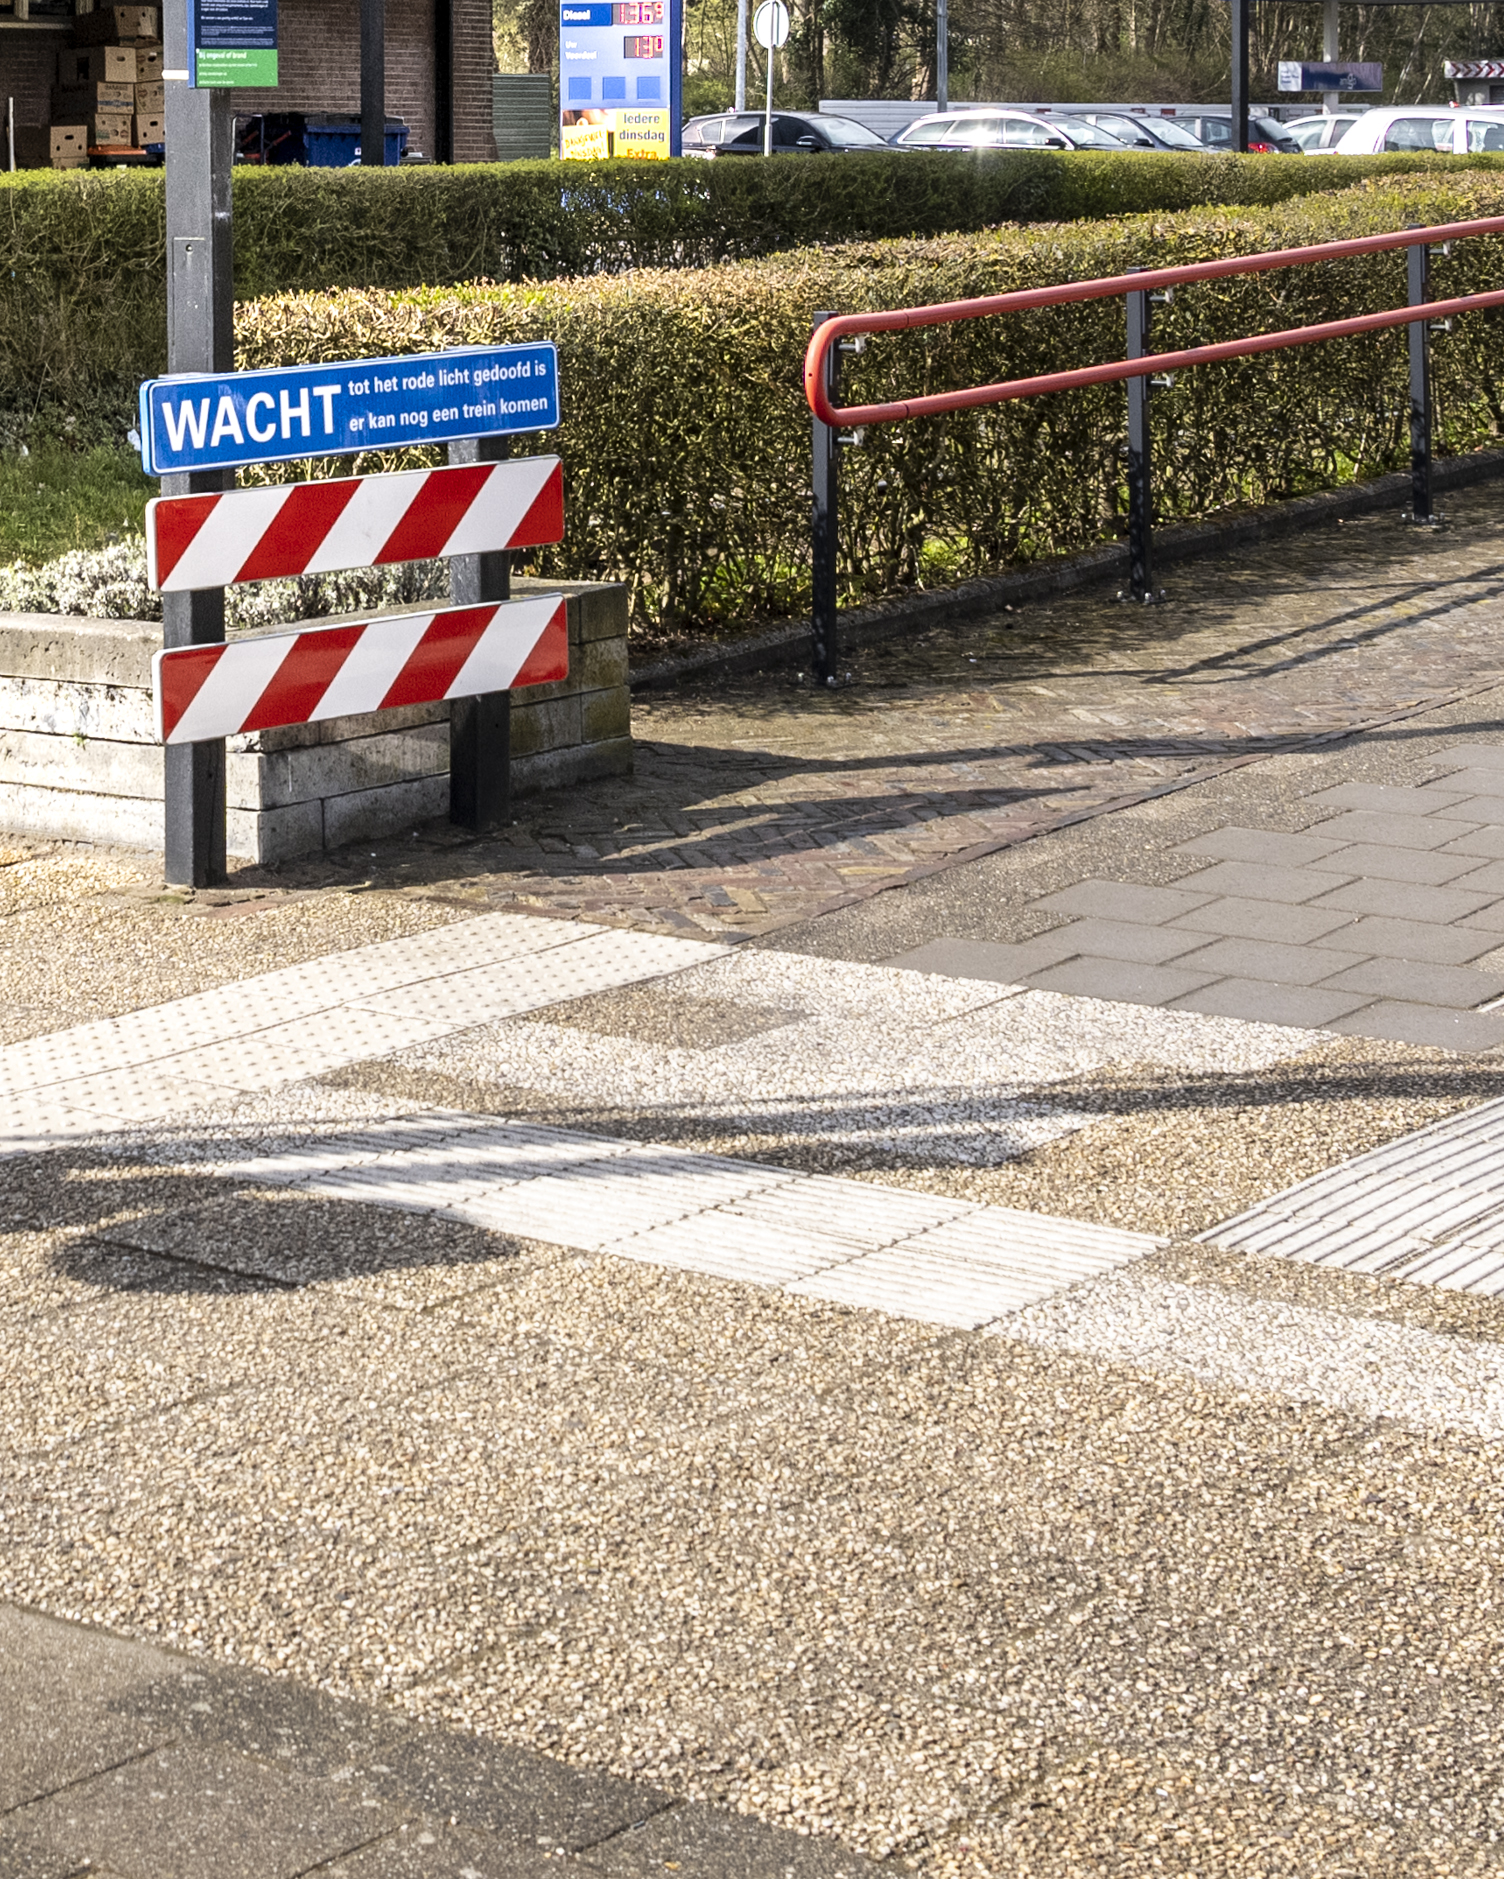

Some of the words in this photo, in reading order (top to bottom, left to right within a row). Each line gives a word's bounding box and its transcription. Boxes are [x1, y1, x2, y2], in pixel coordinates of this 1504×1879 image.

[563, 9, 591, 20] Diesel
[624, 113, 660, 124] Iedere
[619, 130, 665, 142] dinsdag
[161, 385, 341, 452] WACHT
[348, 379, 370, 395] tot
[374, 376, 398, 393] het
[402, 372, 435, 390] rode
[439, 368, 470, 386] licht
[474, 361, 531, 386] gedoofd
[535, 360, 546, 376] is
[349, 418, 365, 431] er
[369, 412, 395, 429] kan
[400, 411, 428, 427] nog
[432, 407, 459, 422] een
[463, 400, 496, 418] trein
[500, 397, 548, 414] komen
